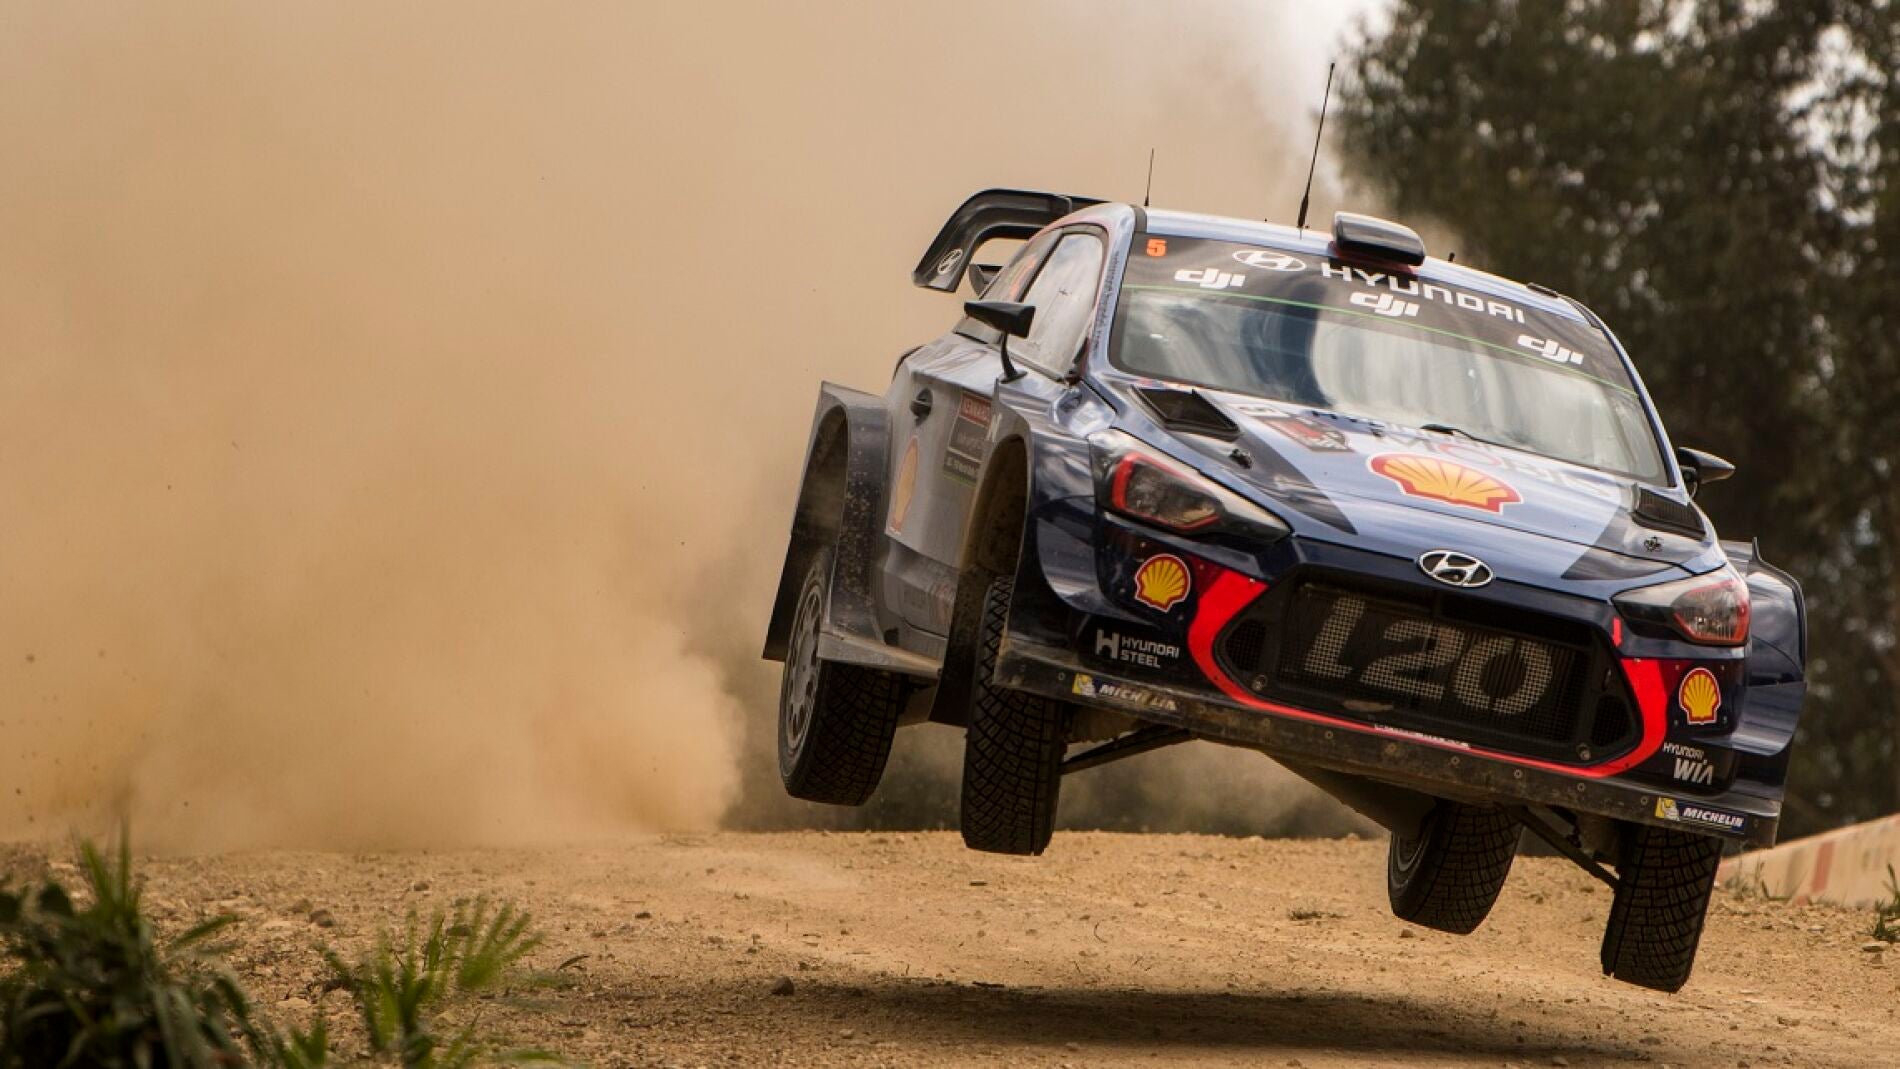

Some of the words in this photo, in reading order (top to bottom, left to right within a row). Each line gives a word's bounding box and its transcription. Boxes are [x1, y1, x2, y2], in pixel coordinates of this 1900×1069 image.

[1146, 238, 1167, 257] 5
[1321, 262, 1526, 324] HYUNDAI
[1121, 636, 1179, 658] HYUNDAI
[1120, 649, 1160, 667] STEEL
[1663, 742, 1704, 759] HYUNDAI
[1673, 758, 1714, 785] WIA
[1683, 807, 1744, 827] MICHELIN
